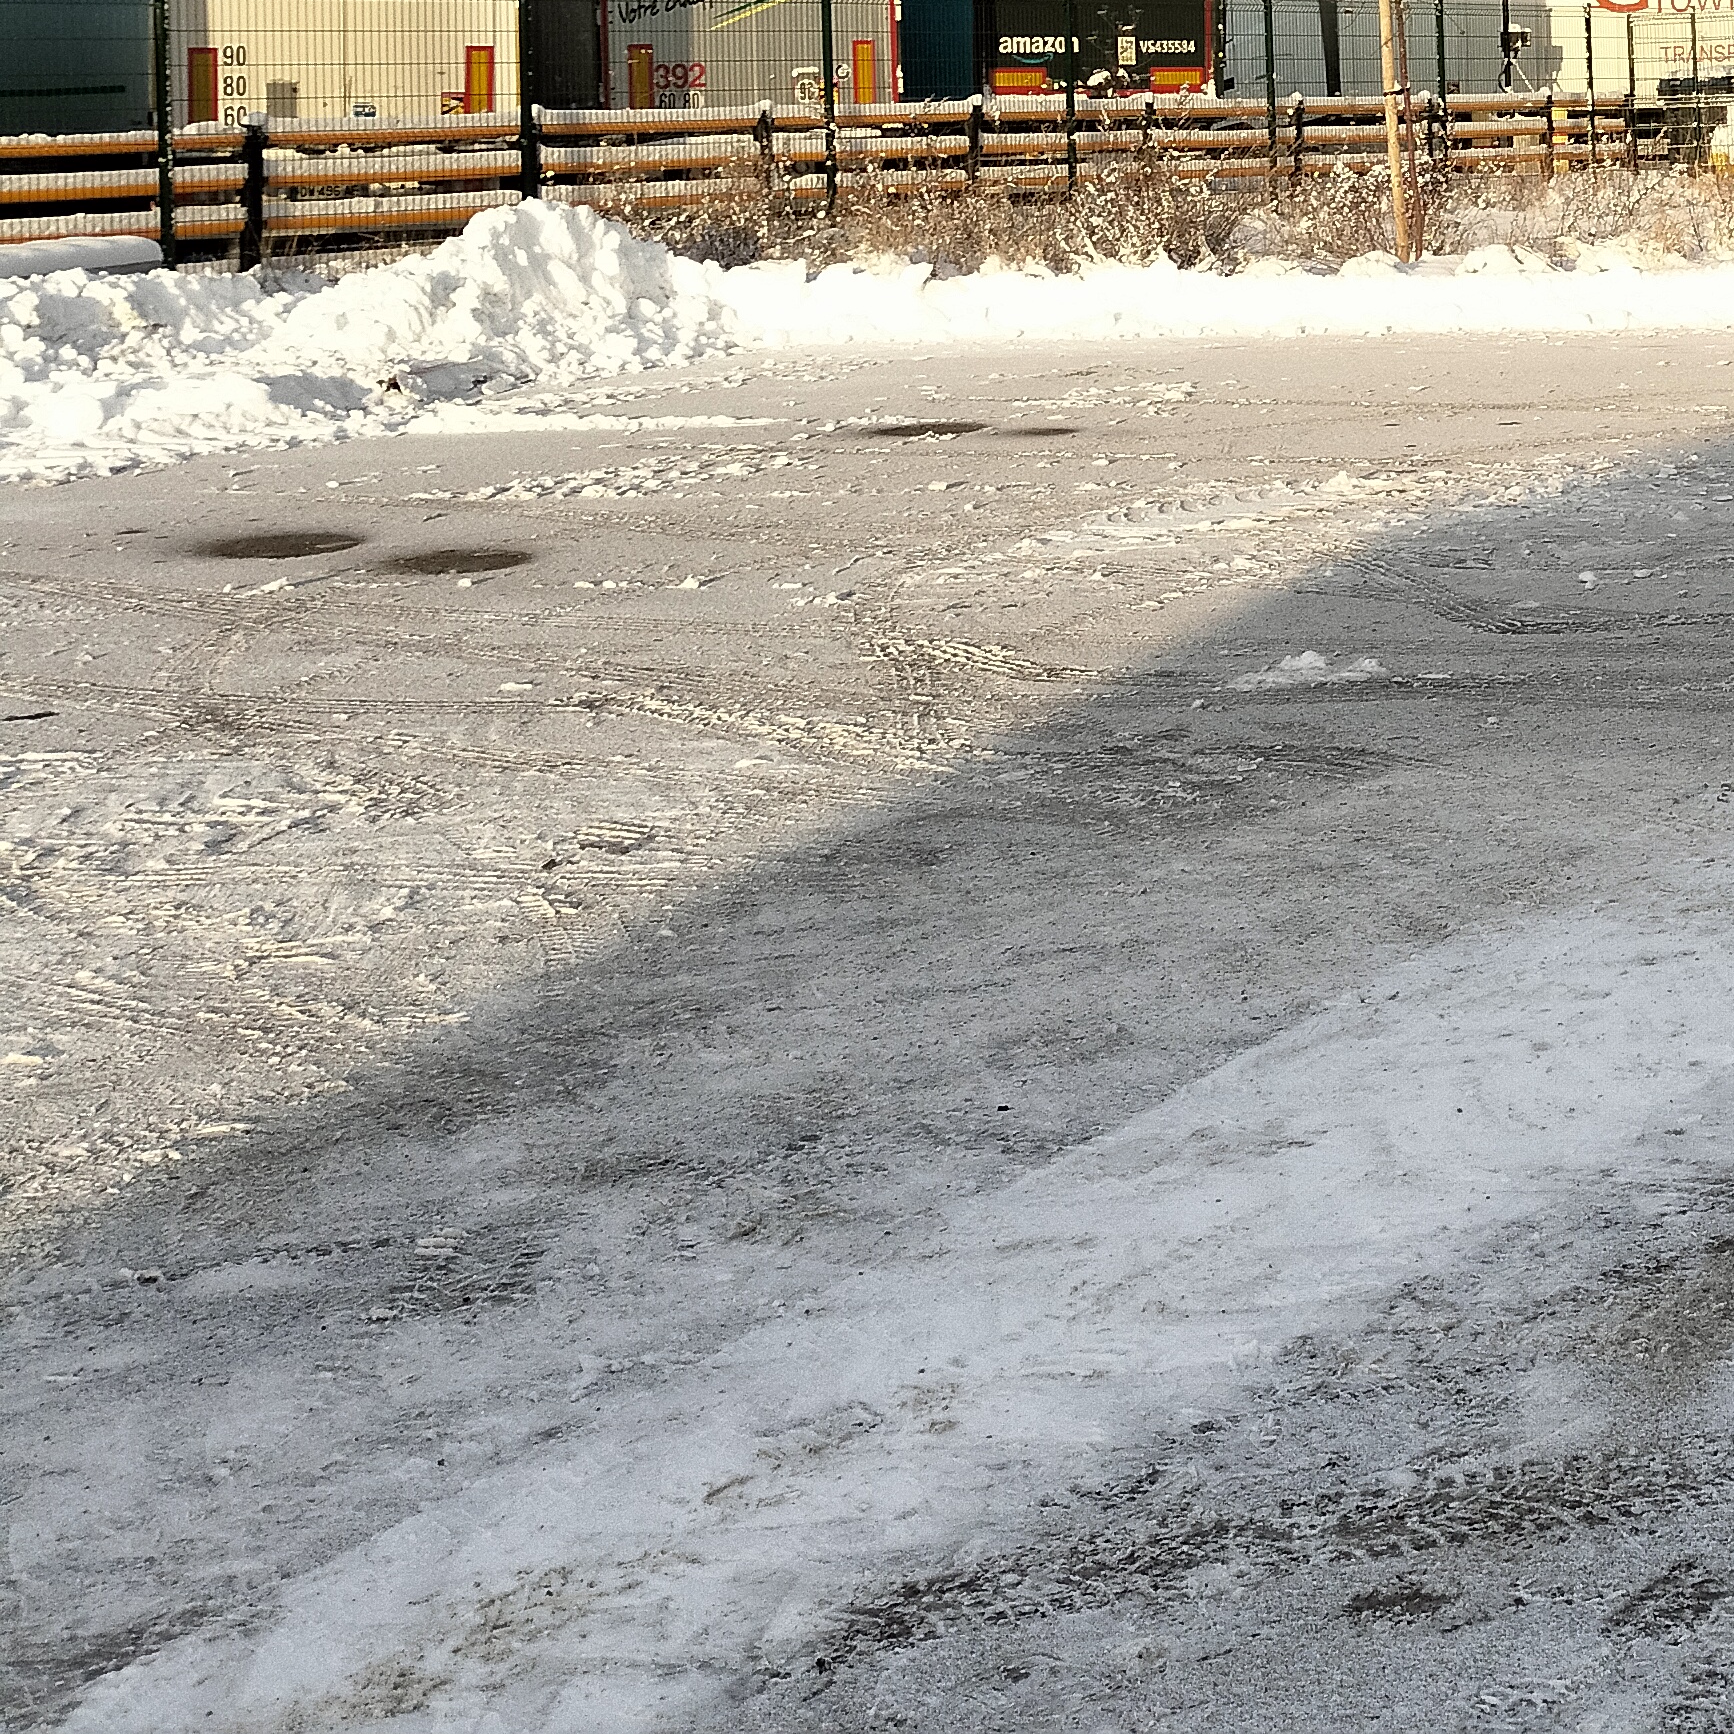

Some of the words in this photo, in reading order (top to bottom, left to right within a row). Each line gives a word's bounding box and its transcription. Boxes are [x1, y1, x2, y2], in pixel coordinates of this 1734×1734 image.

[222, 45, 247, 66] 90
[223, 75, 247, 97] 80
[653, 63, 706, 89] 392
